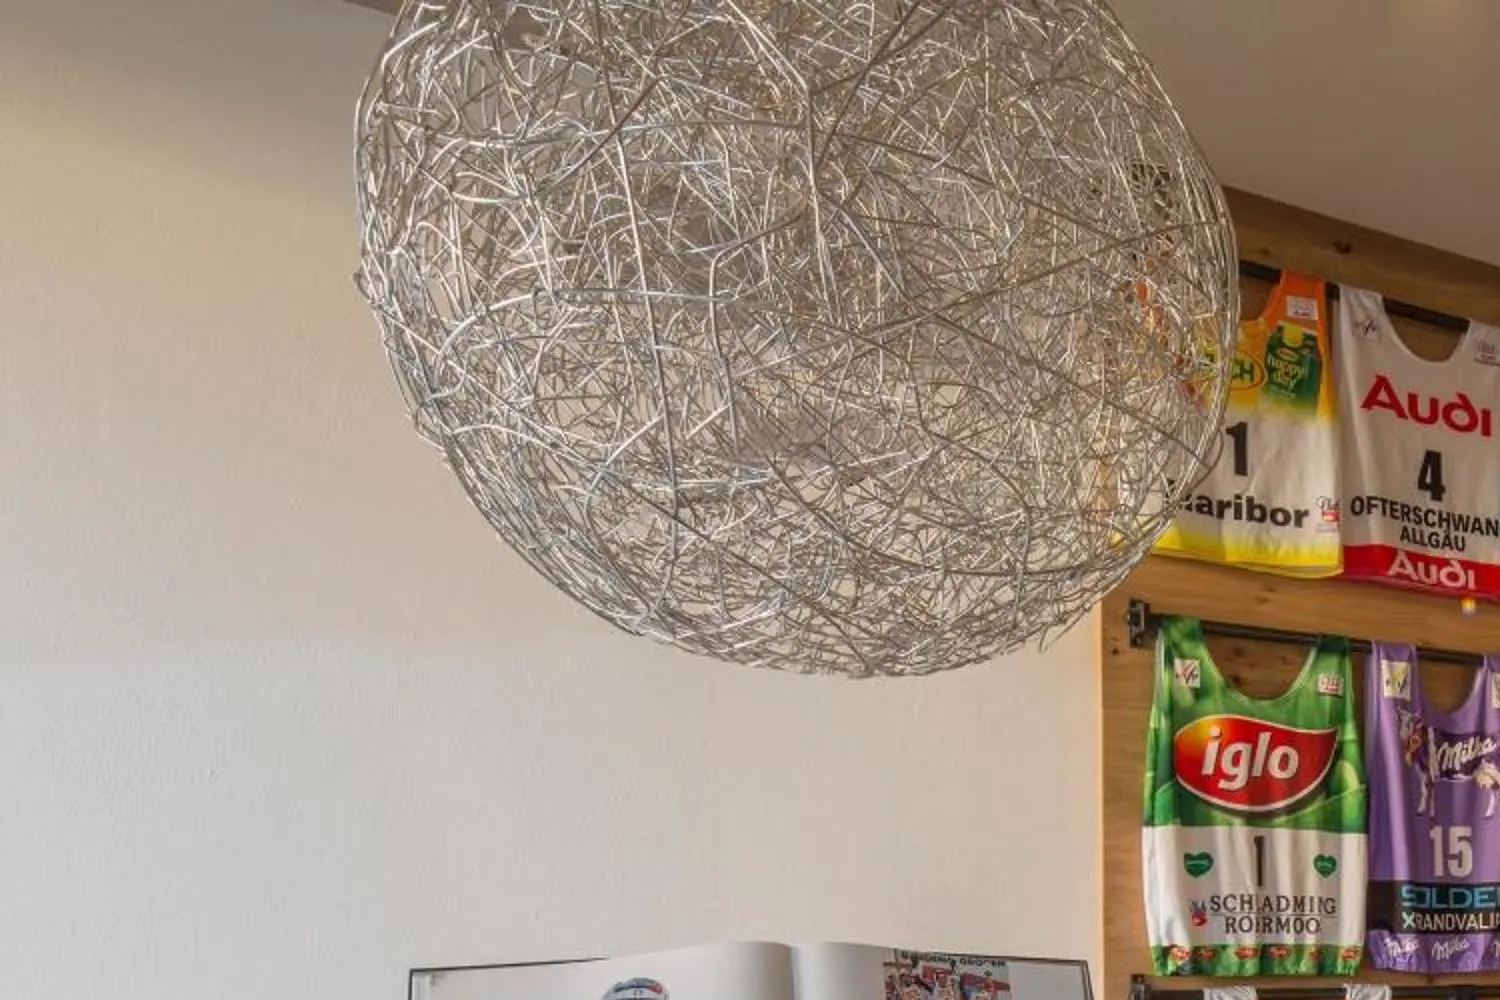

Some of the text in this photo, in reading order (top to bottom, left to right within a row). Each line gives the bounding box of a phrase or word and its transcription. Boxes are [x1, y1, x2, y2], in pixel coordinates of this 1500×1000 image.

[1361, 374, 1493, 437] Audi
[1226, 421, 1249, 476] 1
[1417, 450, 1446, 501] 4
[1387, 553, 1477, 590] Audi
[1201, 724, 1299, 791] iglo
[1430, 825, 1473, 879] 15
